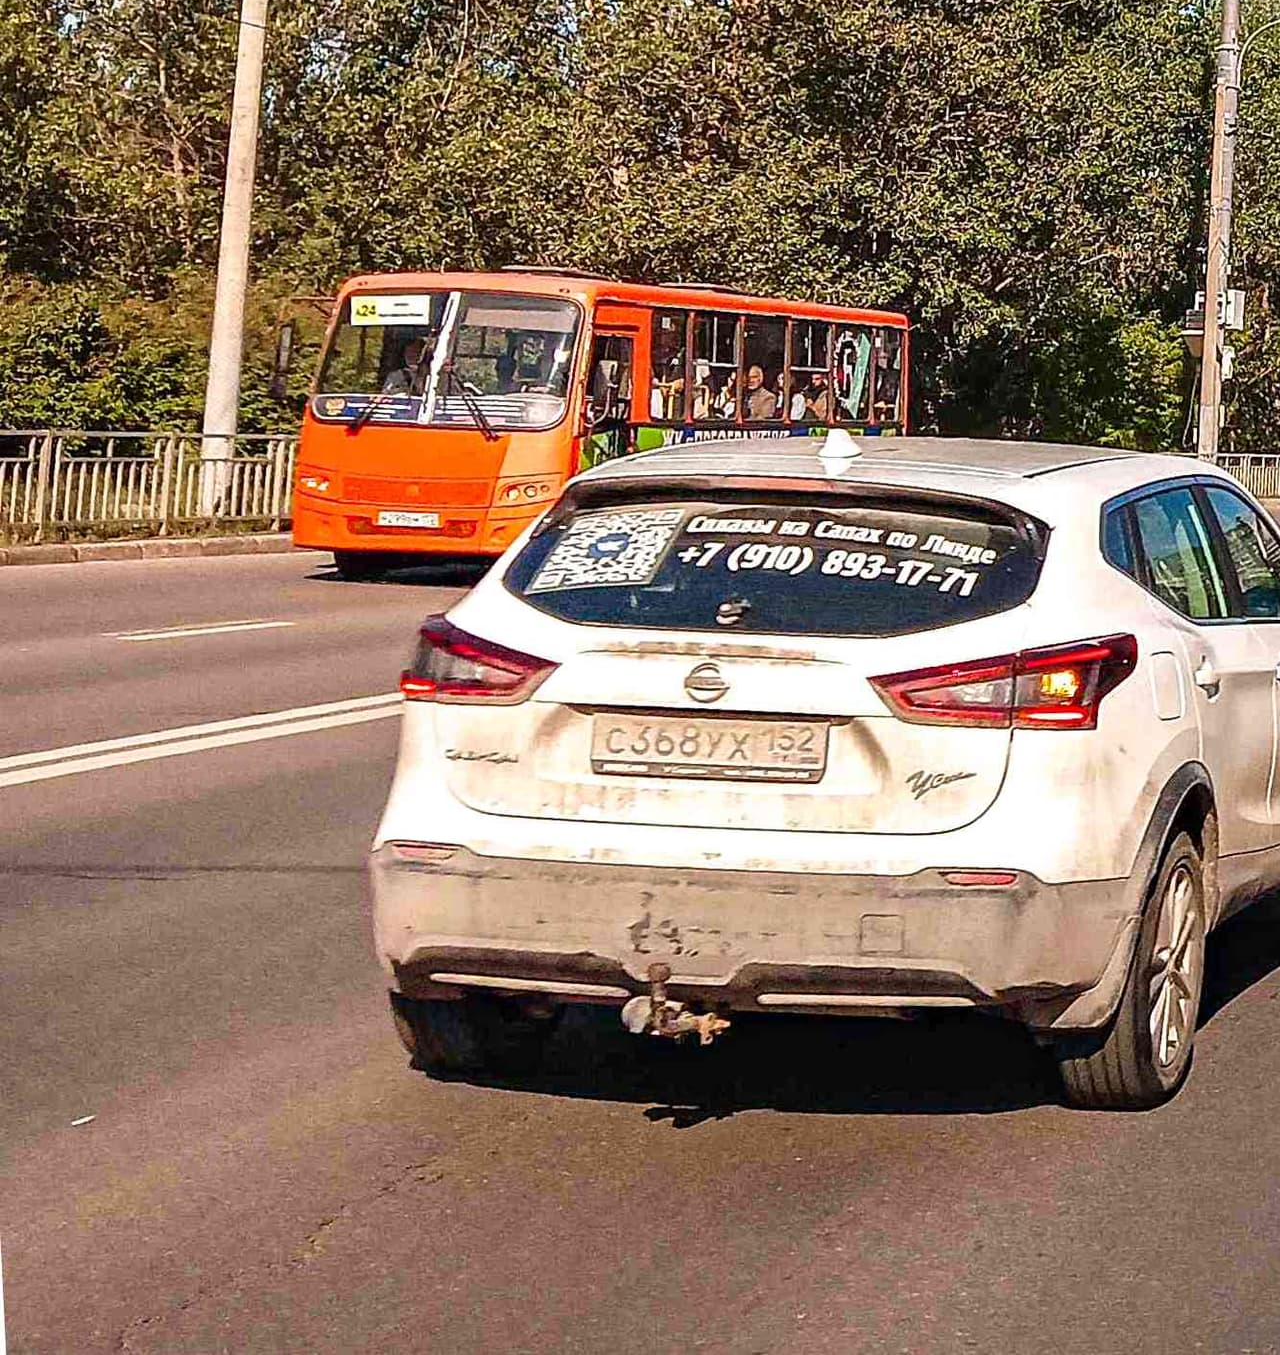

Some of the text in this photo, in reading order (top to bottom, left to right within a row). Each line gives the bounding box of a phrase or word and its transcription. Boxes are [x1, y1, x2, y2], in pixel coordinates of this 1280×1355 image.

[782, 520, 807, 536] на
[813, 521, 884, 547] Сапах
[888, 531, 916, 550] по
[921, 534, 998, 567] Линде
[677, 542, 980, 598] +7 (910) 893-17-71
[766, 728, 816, 754] 152
